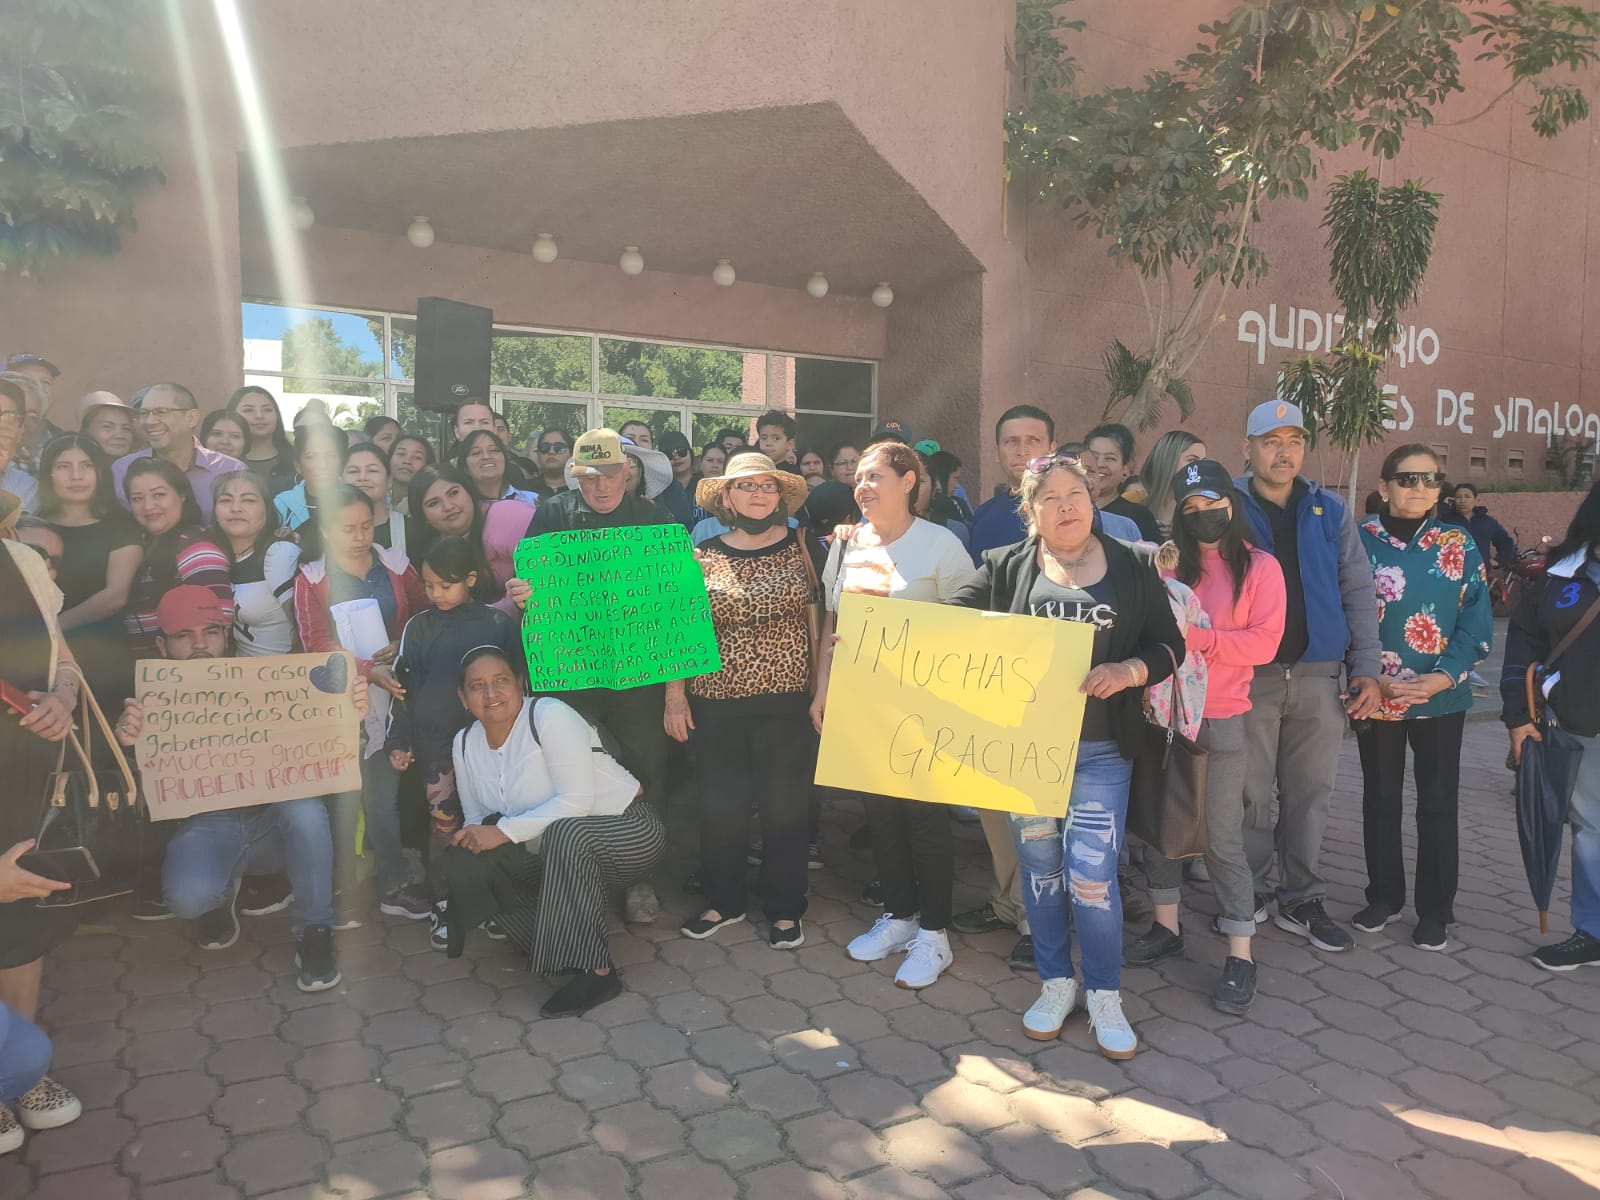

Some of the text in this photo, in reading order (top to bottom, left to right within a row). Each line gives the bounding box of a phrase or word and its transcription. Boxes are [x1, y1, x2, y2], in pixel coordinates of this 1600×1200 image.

[1436, 388, 1475, 433] DE
[577, 572, 594, 587] EN
[1555, 582, 1581, 608] 3
[141, 688, 249, 708] estamos
[147, 703, 282, 732] agradecidos
[327, 704, 343, 721] el
[146, 728, 272, 758] gobernador
[271, 735, 347, 767] gracias
[156, 770, 255, 804] RUBEN
